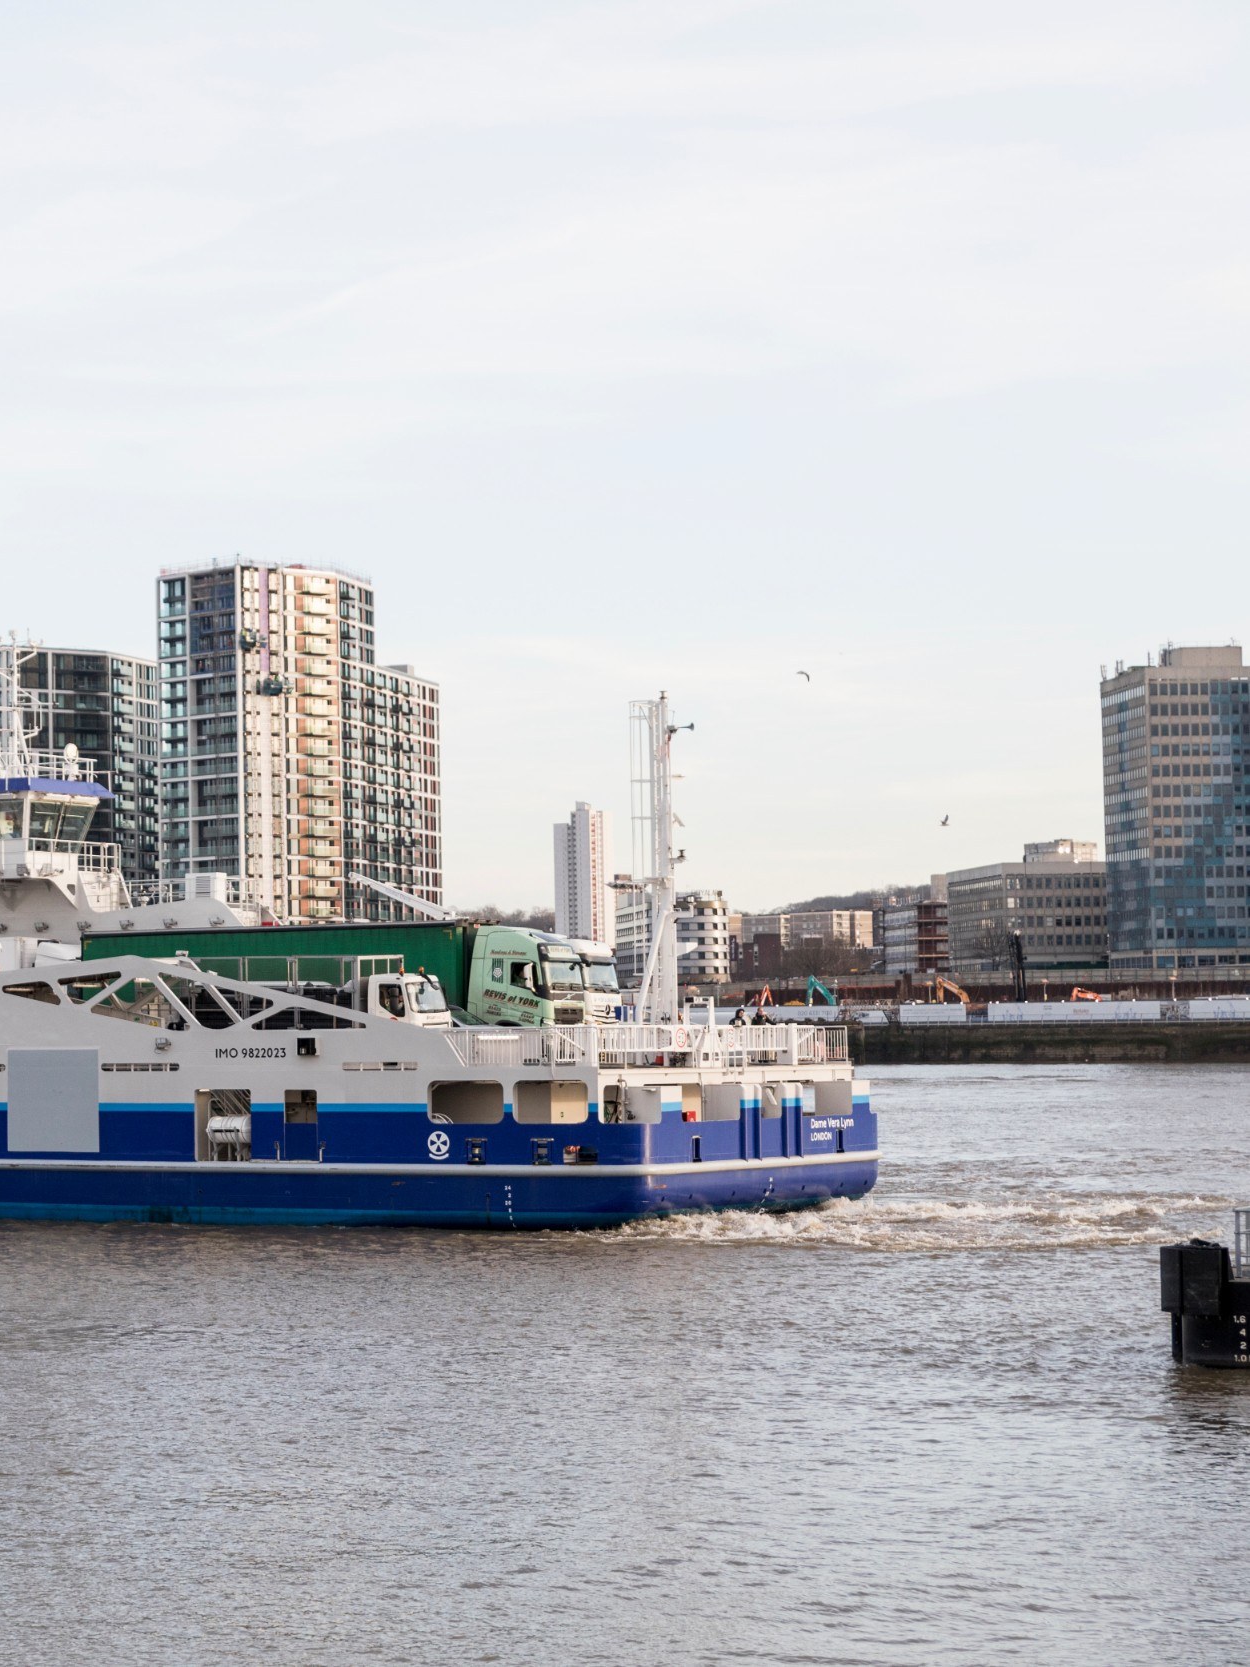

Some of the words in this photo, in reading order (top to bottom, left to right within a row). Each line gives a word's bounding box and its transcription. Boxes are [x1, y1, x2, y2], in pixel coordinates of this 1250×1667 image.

[483, 988, 507, 1000] REVIS
[519, 996, 541, 1008] YORK
[215, 1047, 239, 1059] IMO
[241, 1047, 287, 1059] 9822023
[810, 1118, 827, 1129] Dame
[827, 1117, 841, 1128] Vera
[840, 1117, 855, 1129] Lynn
[810, 1131, 833, 1142] LONDON
[1233, 1315, 1247, 1324] 1.6
[1239, 1328, 1247, 1337] 4
[1240, 1341, 1247, 1349] 2
